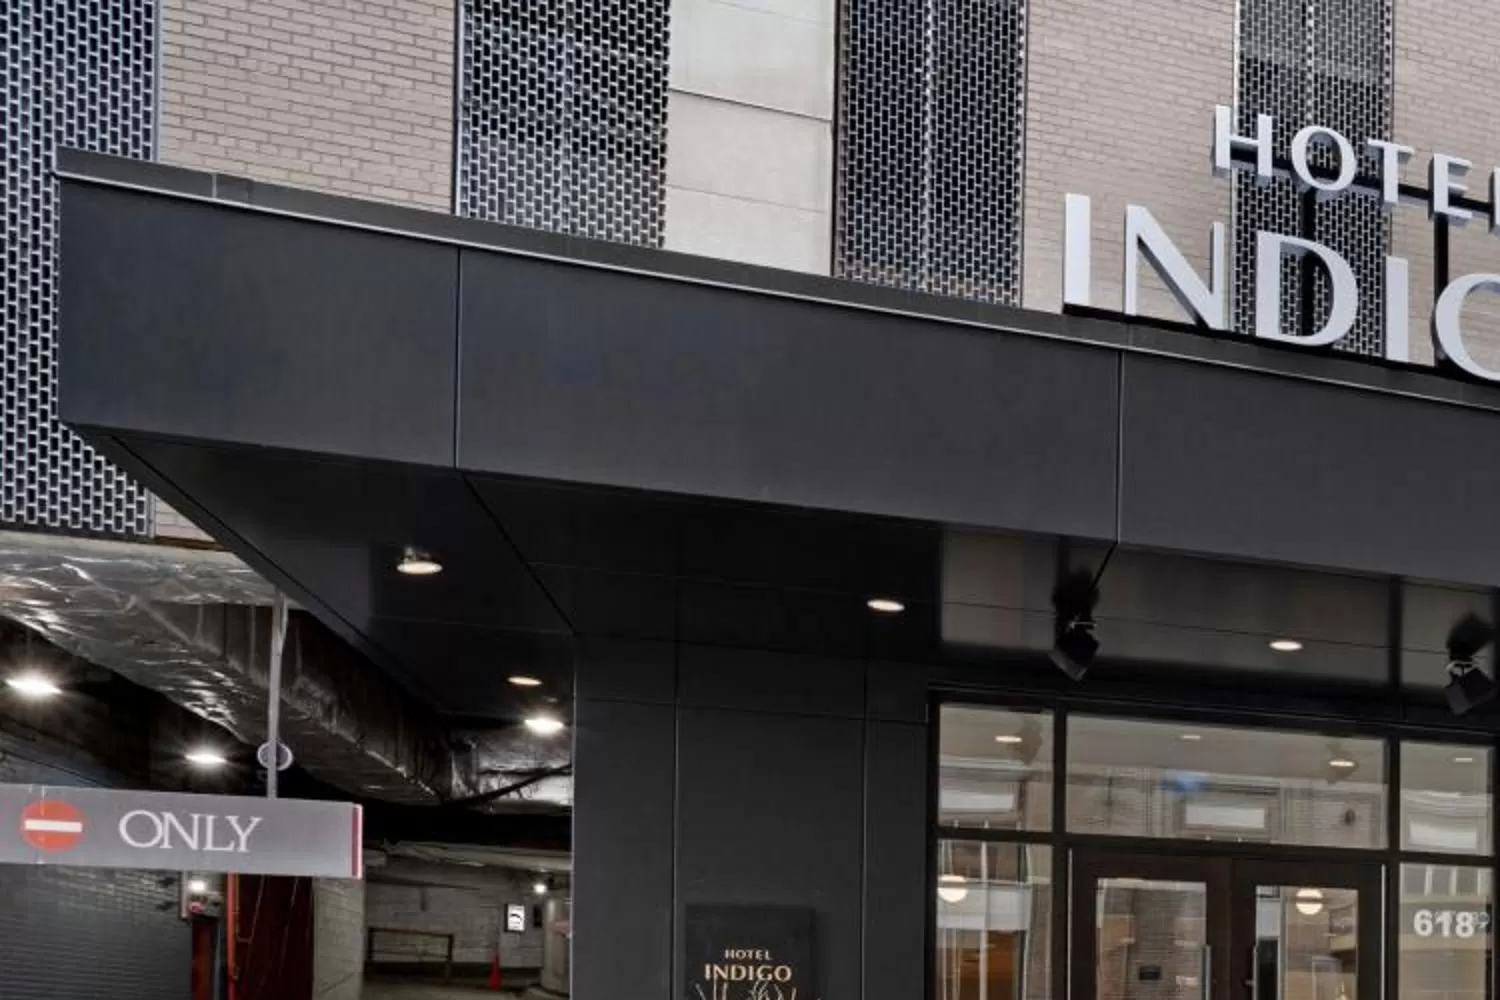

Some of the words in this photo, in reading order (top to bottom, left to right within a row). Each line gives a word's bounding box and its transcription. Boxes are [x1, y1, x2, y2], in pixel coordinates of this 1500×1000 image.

[118, 810, 263, 853] ONLY
[1413, 909, 1474, 938] 618
[724, 948, 772, 961] HOTEL
[704, 963, 793, 982] INDIGO
